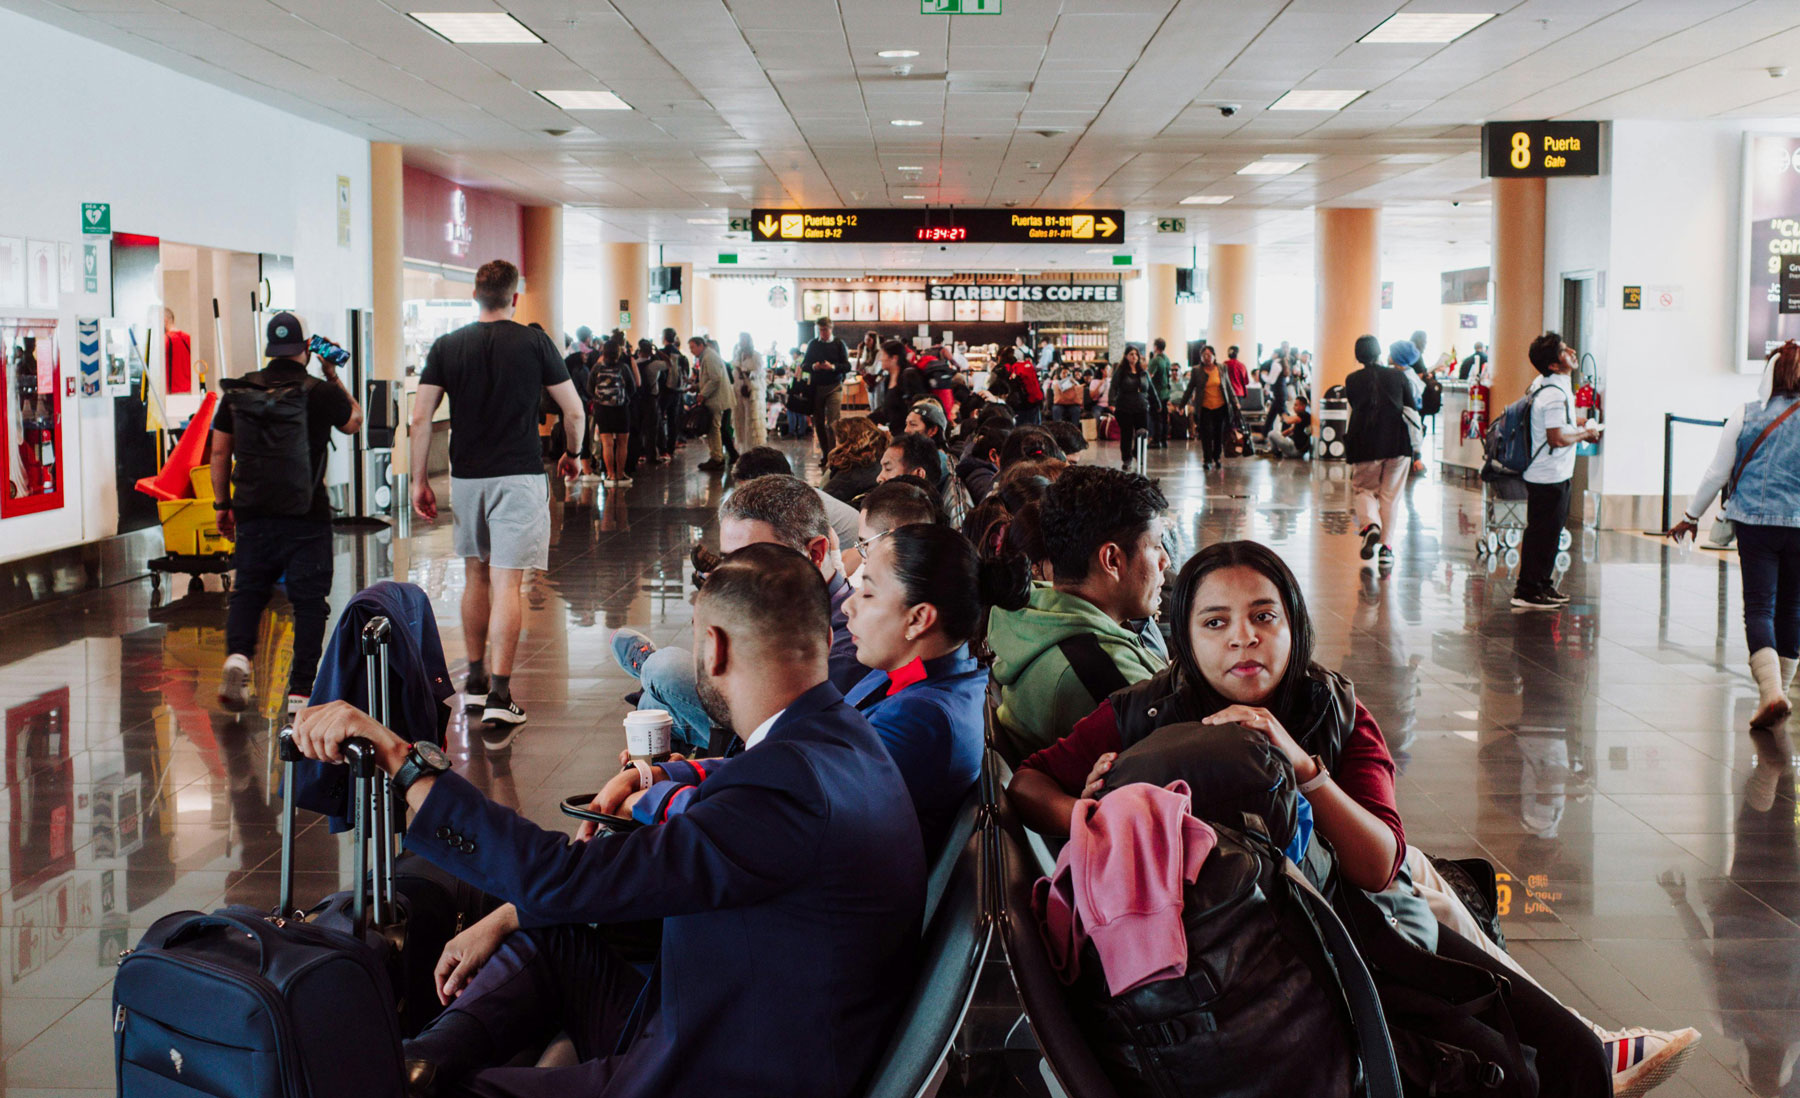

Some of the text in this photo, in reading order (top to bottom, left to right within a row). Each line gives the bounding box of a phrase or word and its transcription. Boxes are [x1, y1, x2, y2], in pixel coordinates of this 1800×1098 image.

[1544, 136, 1581, 151] Puerta
[1511, 132, 1531, 169] 8
[1544, 155, 1566, 168] Gate
[804, 214, 857, 226] Puertas 9-12
[1011, 215, 1042, 226] Puertas
[804, 229, 842, 238] Gates 9-12
[918, 228, 966, 239] 11:34:27
[1029, 229, 1048, 238] Gates
[931, 286, 1118, 300] STARBUCKS COFFEE
